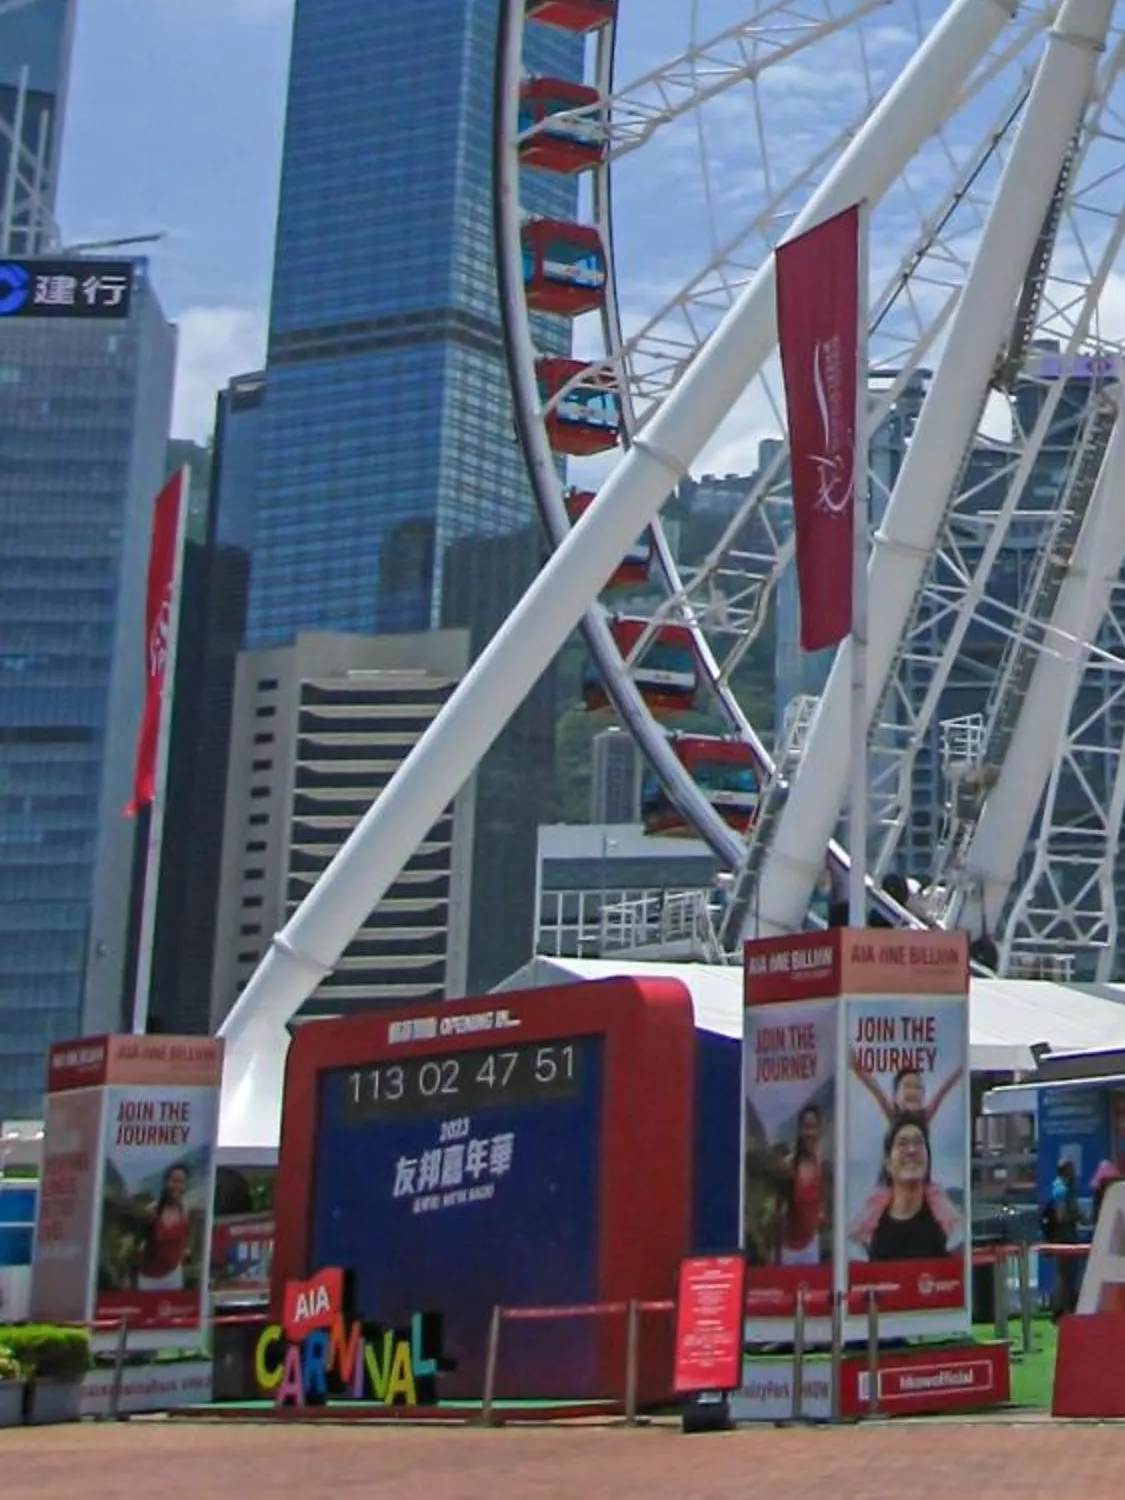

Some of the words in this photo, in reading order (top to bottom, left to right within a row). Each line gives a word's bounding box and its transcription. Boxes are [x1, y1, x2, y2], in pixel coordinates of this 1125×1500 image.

[33, 275, 127, 305] 建行
[851, 944, 875, 964] AIA
[879, 945, 906, 964] ONE
[910, 945, 959, 964] BILLION
[756, 1025, 785, 1053] JOIN
[790, 1023, 815, 1049] THE
[856, 1017, 894, 1042] JOIN
[901, 1016, 936, 1041] THE
[350, 1067, 404, 1102] 113
[419, 1061, 459, 1095] 02
[476, 1053, 518, 1088] 47
[535, 1046, 574, 1082] 51
[756, 1054, 817, 1082] JOURNEY
[856, 1048, 937, 1073] JOURNEY
[117, 1101, 154, 1122] JOIN
[160, 1101, 191, 1122] THE
[116, 1125, 191, 1146] JOURNEY
[294, 1285, 331, 1322] AIA
[256, 1312, 437, 1407] CARNIVAL
